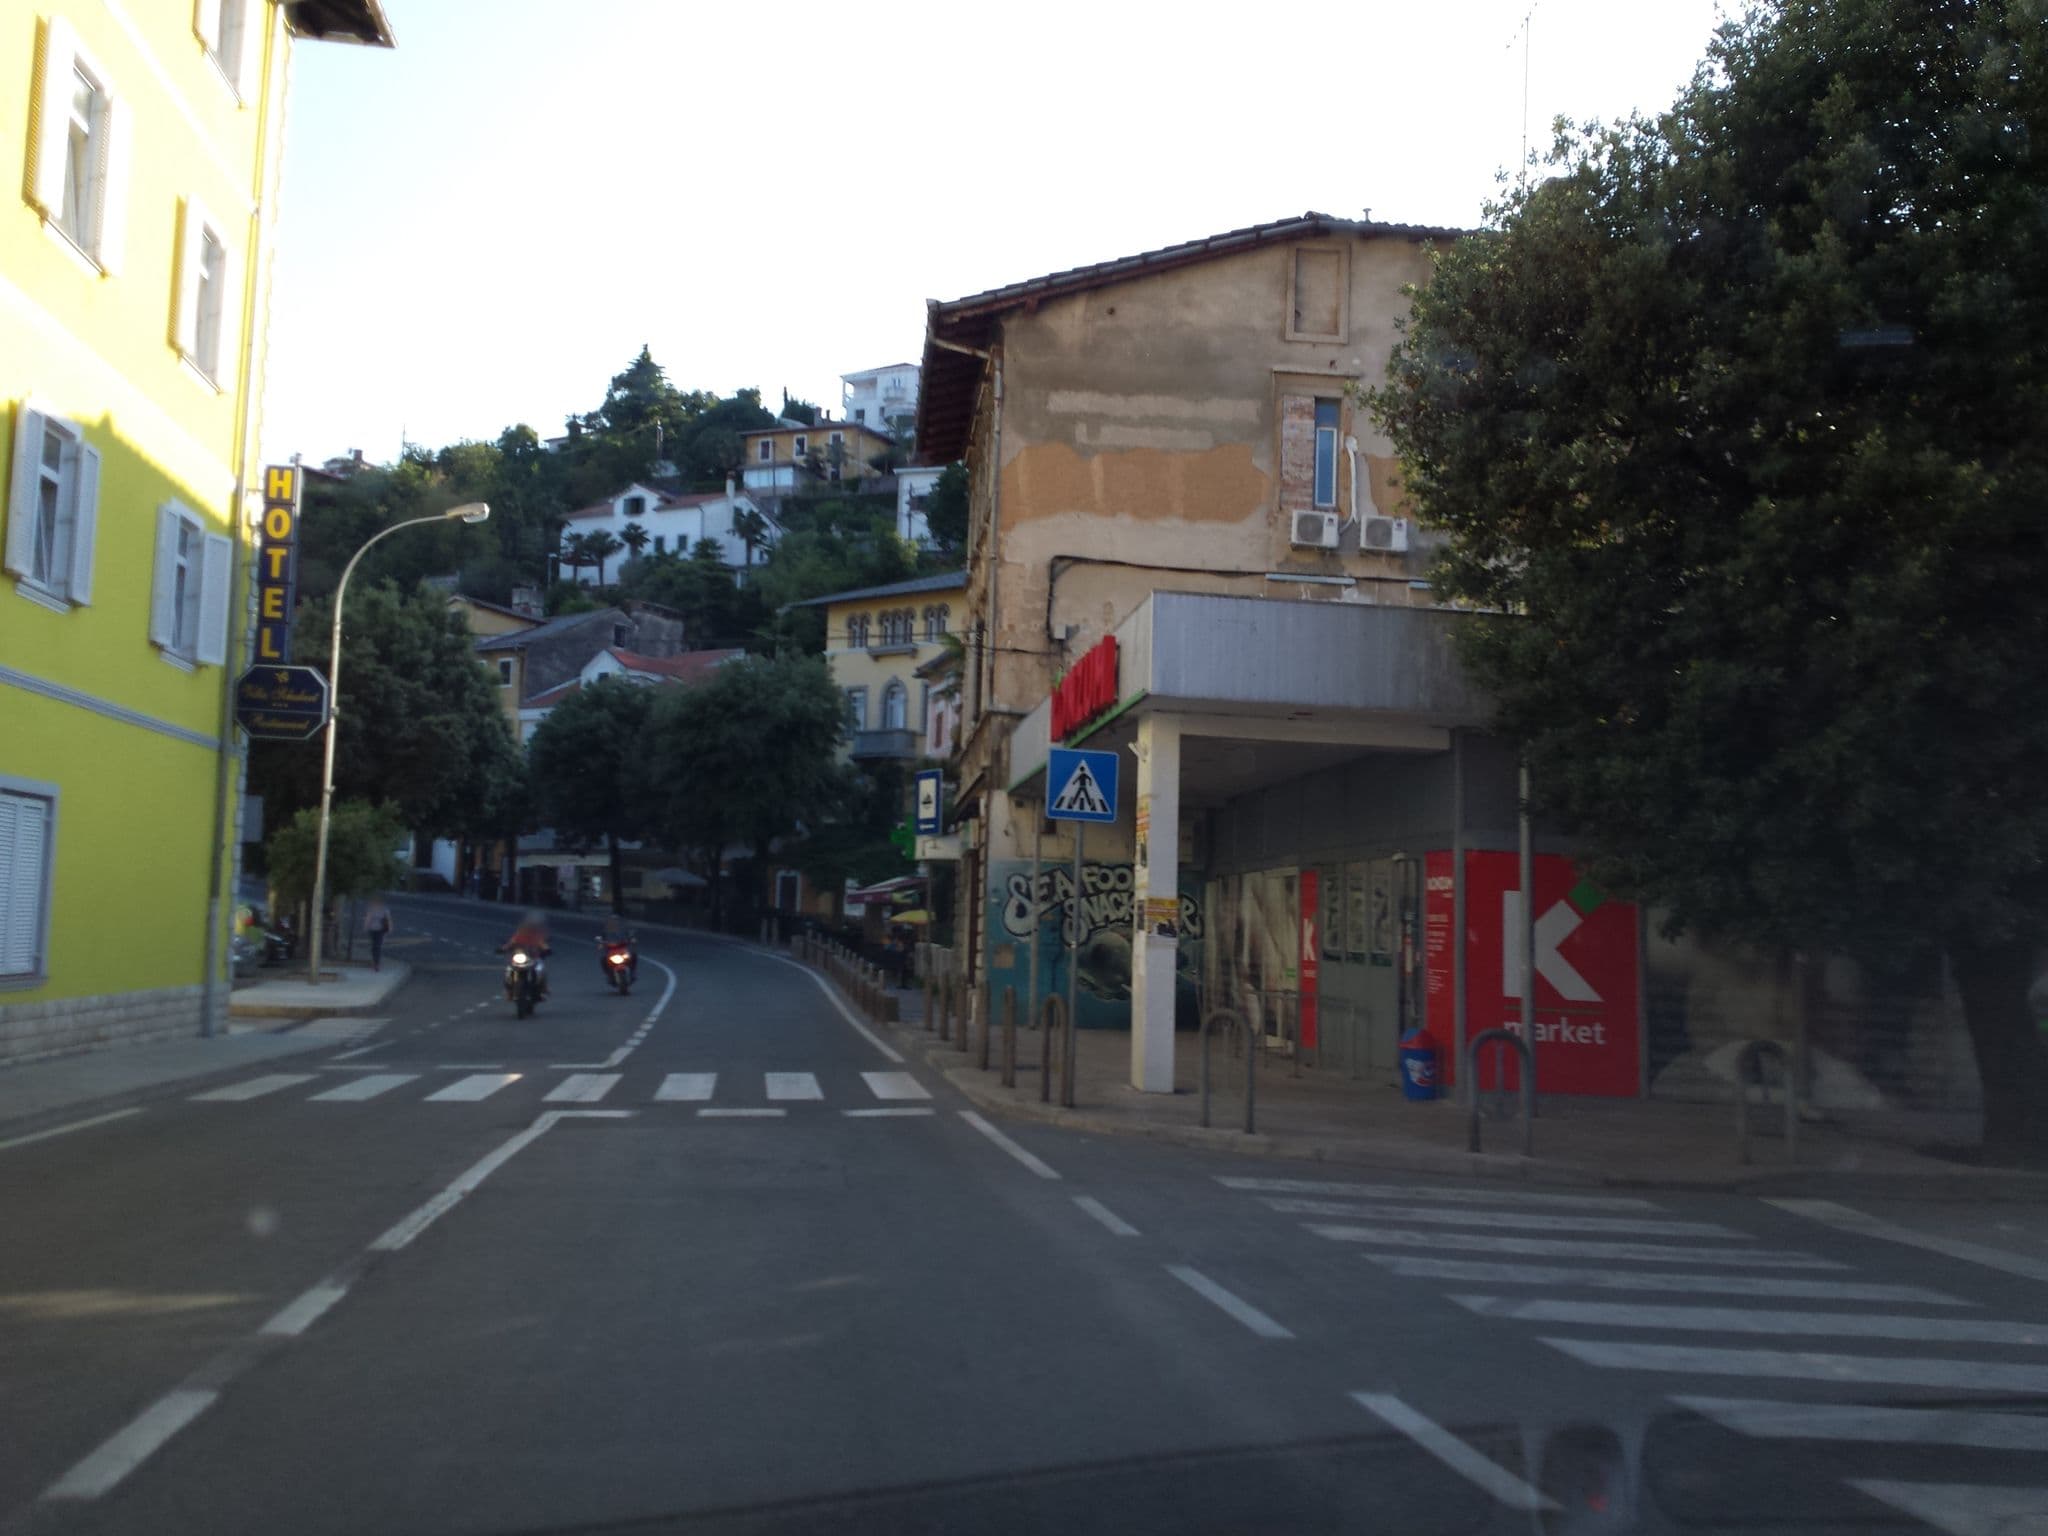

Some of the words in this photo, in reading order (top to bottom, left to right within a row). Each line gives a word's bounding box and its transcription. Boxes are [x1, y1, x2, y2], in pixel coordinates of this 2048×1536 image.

[260, 468, 293, 658] HOTEL
[1003, 868, 1077, 936] SEA
[1079, 865, 1133, 893] FOO
[1503, 890, 1605, 1002] K
